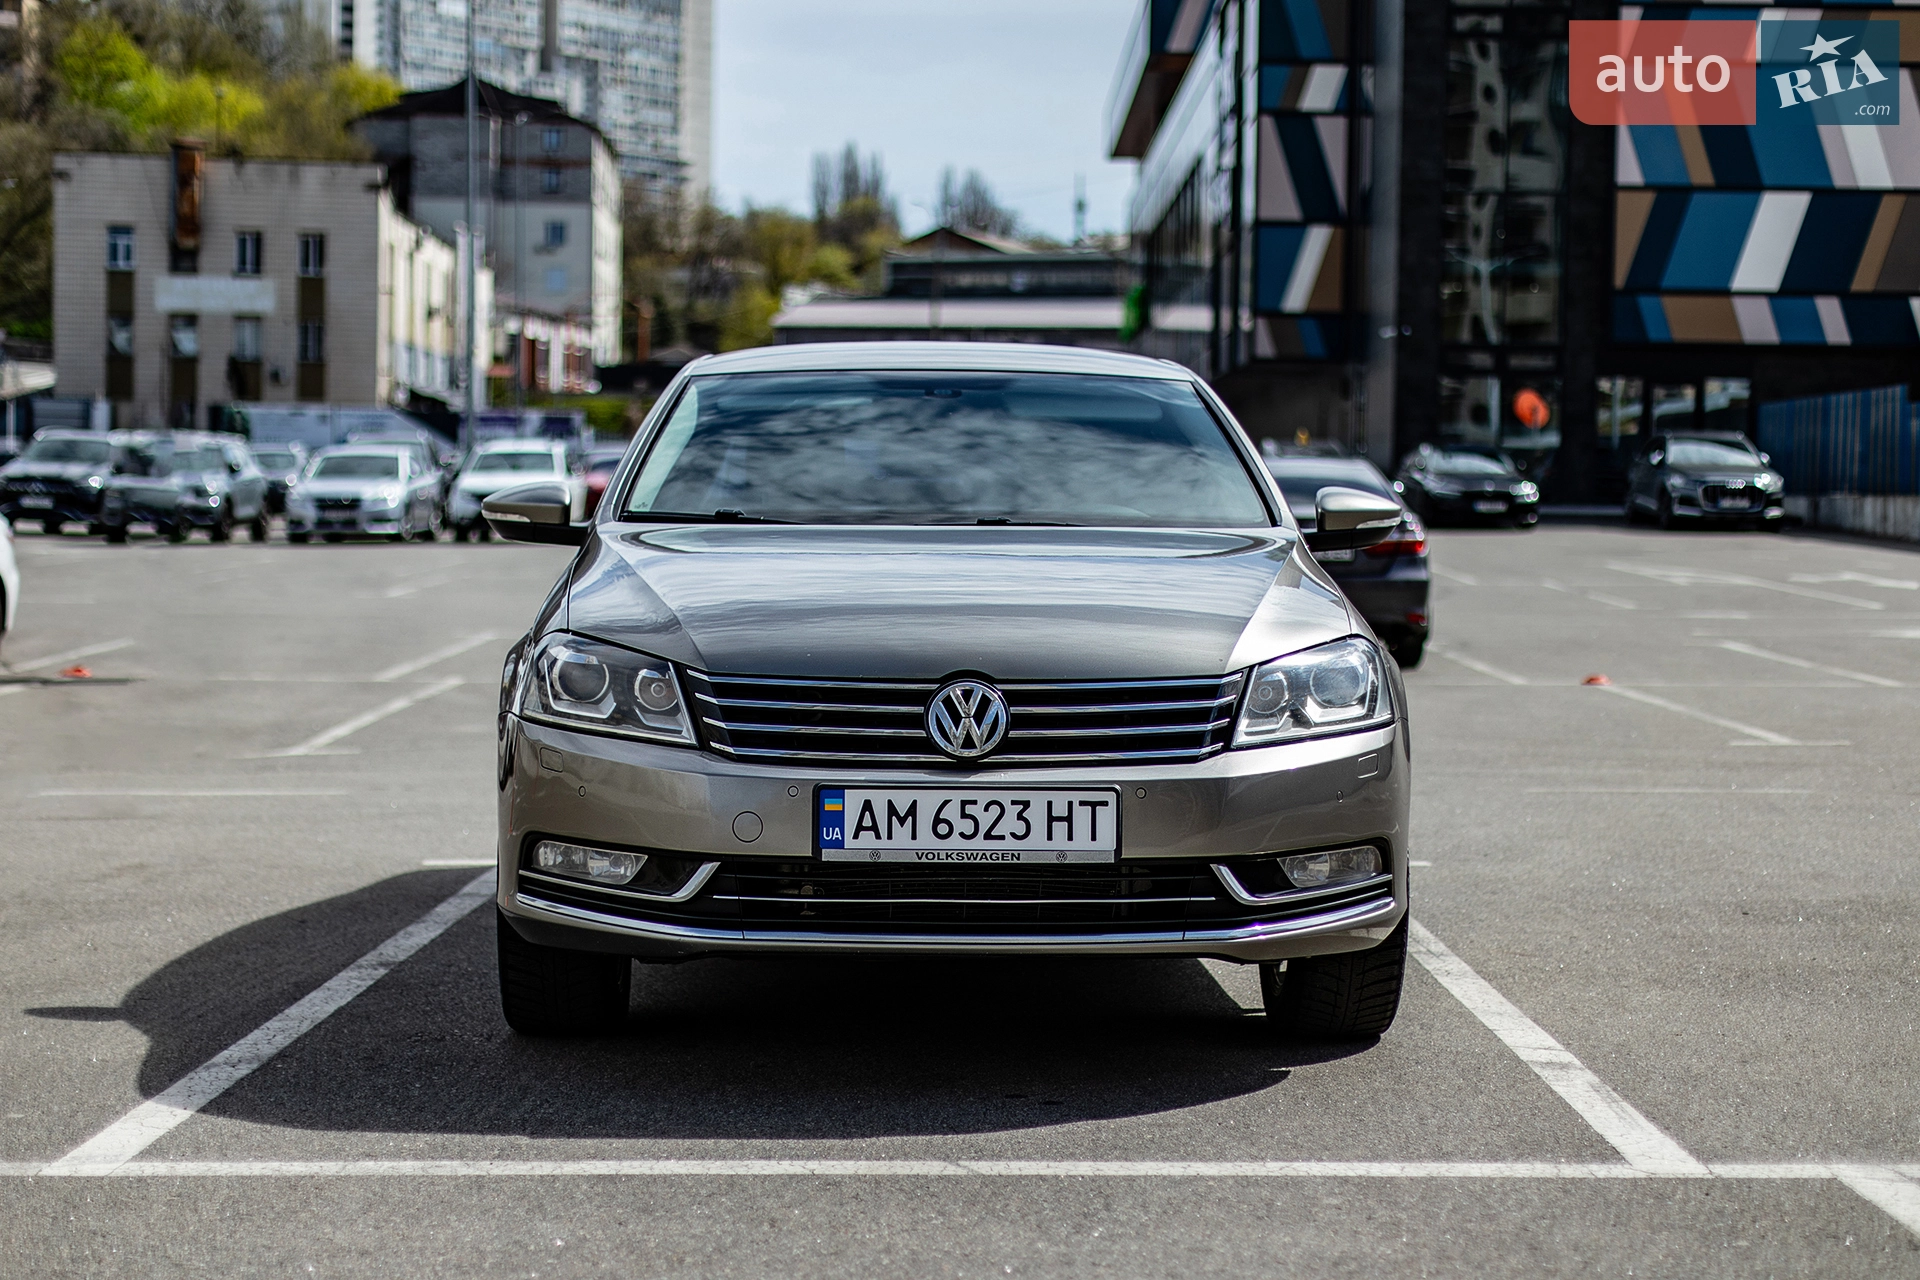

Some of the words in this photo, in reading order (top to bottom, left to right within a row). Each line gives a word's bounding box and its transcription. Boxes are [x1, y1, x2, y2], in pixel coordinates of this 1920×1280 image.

[851, 799, 918, 841] AM
[931, 799, 1032, 841] 6523
[1046, 800, 1109, 842] HT
[823, 827, 842, 840] UA
[915, 851, 1021, 862] VOLKSWAGEN
